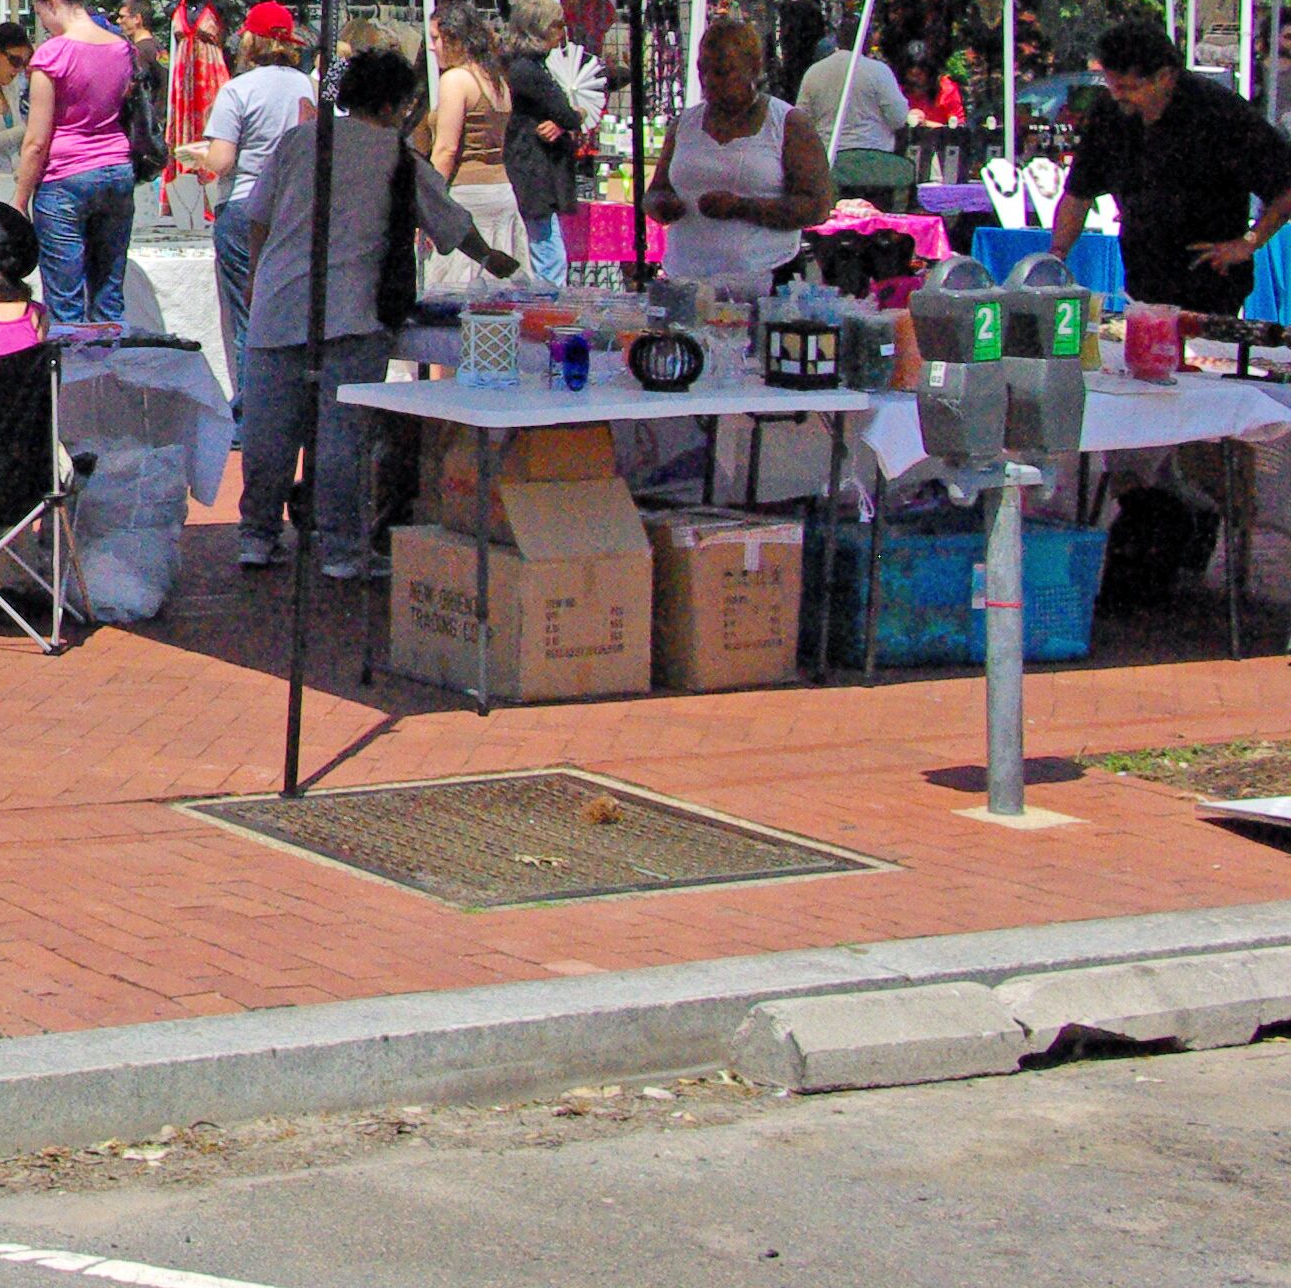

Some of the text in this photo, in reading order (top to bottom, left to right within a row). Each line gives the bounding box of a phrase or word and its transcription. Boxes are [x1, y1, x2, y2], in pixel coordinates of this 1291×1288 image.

[977, 307, 994, 340] 2
[1057, 302, 1073, 335] 2
[411, 606, 495, 649] TRADING COP
